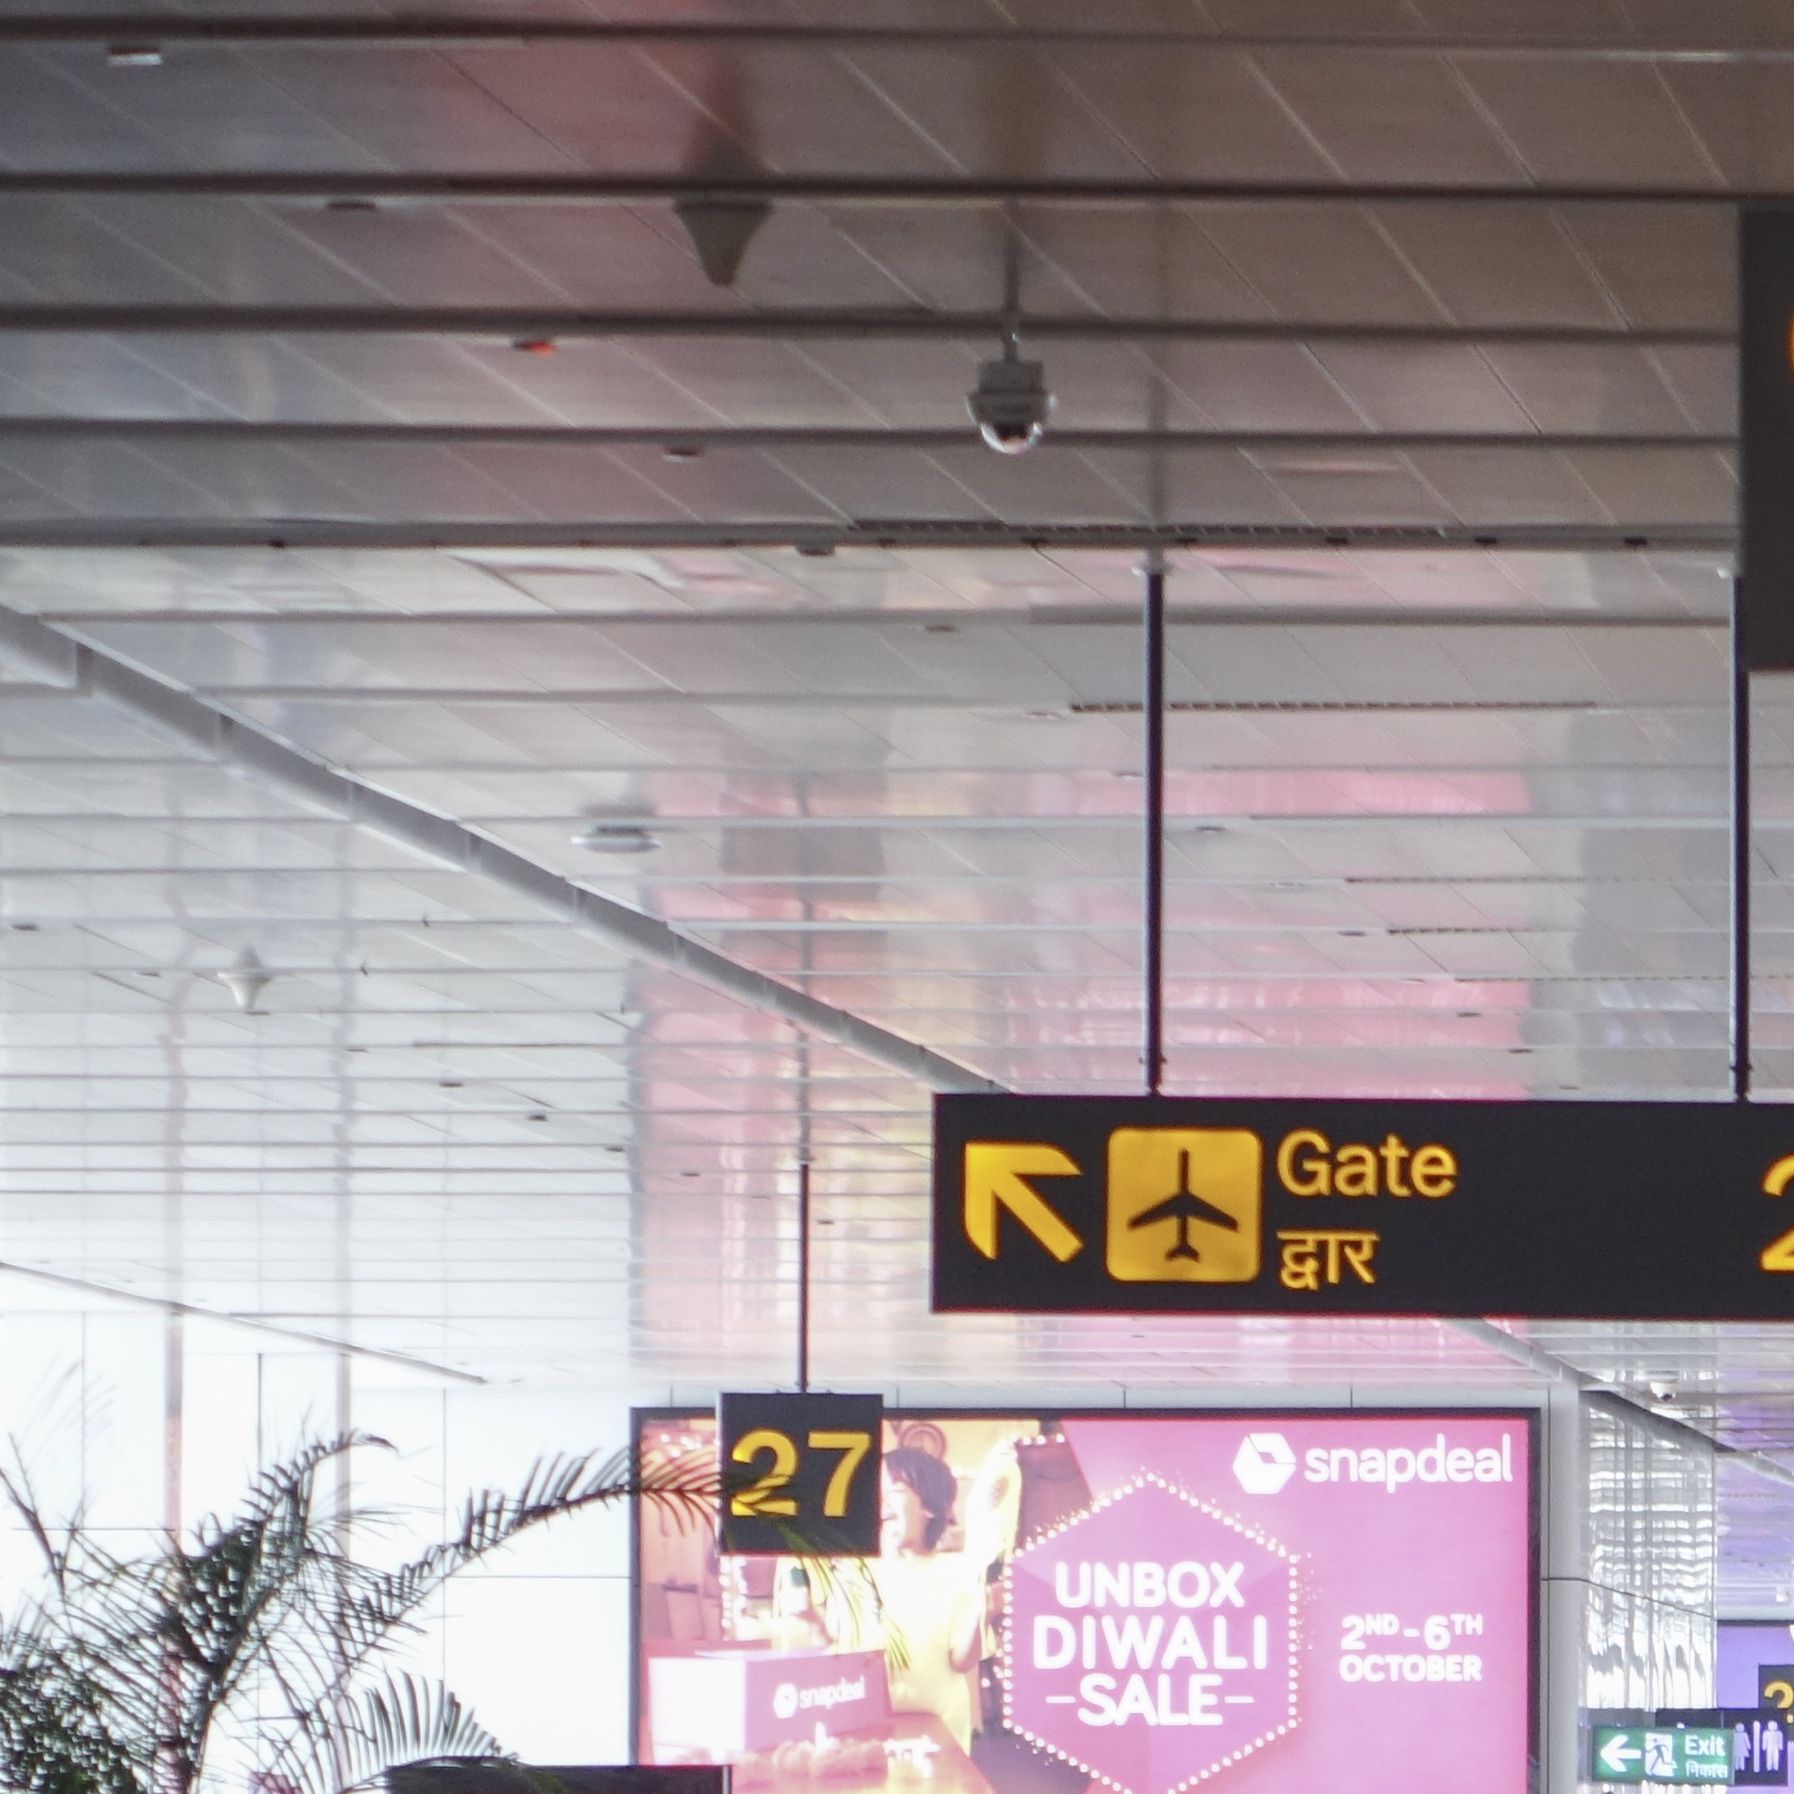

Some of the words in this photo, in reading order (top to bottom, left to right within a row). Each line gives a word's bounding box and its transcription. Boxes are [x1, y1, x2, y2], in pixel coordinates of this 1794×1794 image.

[1278, 1130, 1457, 1199] Gate
[1278, 1230, 1377, 1288] द्वार
[731, 1428, 871, 1517] 27
[1305, 1434, 1513, 1494] snapdeal
[1055, 1562, 1244, 1608] UNBOX
[1032, 1616, 1268, 1669] DIWALI
[1340, 1654, 1482, 1683] OCTOBER
[1685, 1734, 1726, 1757] Exit
